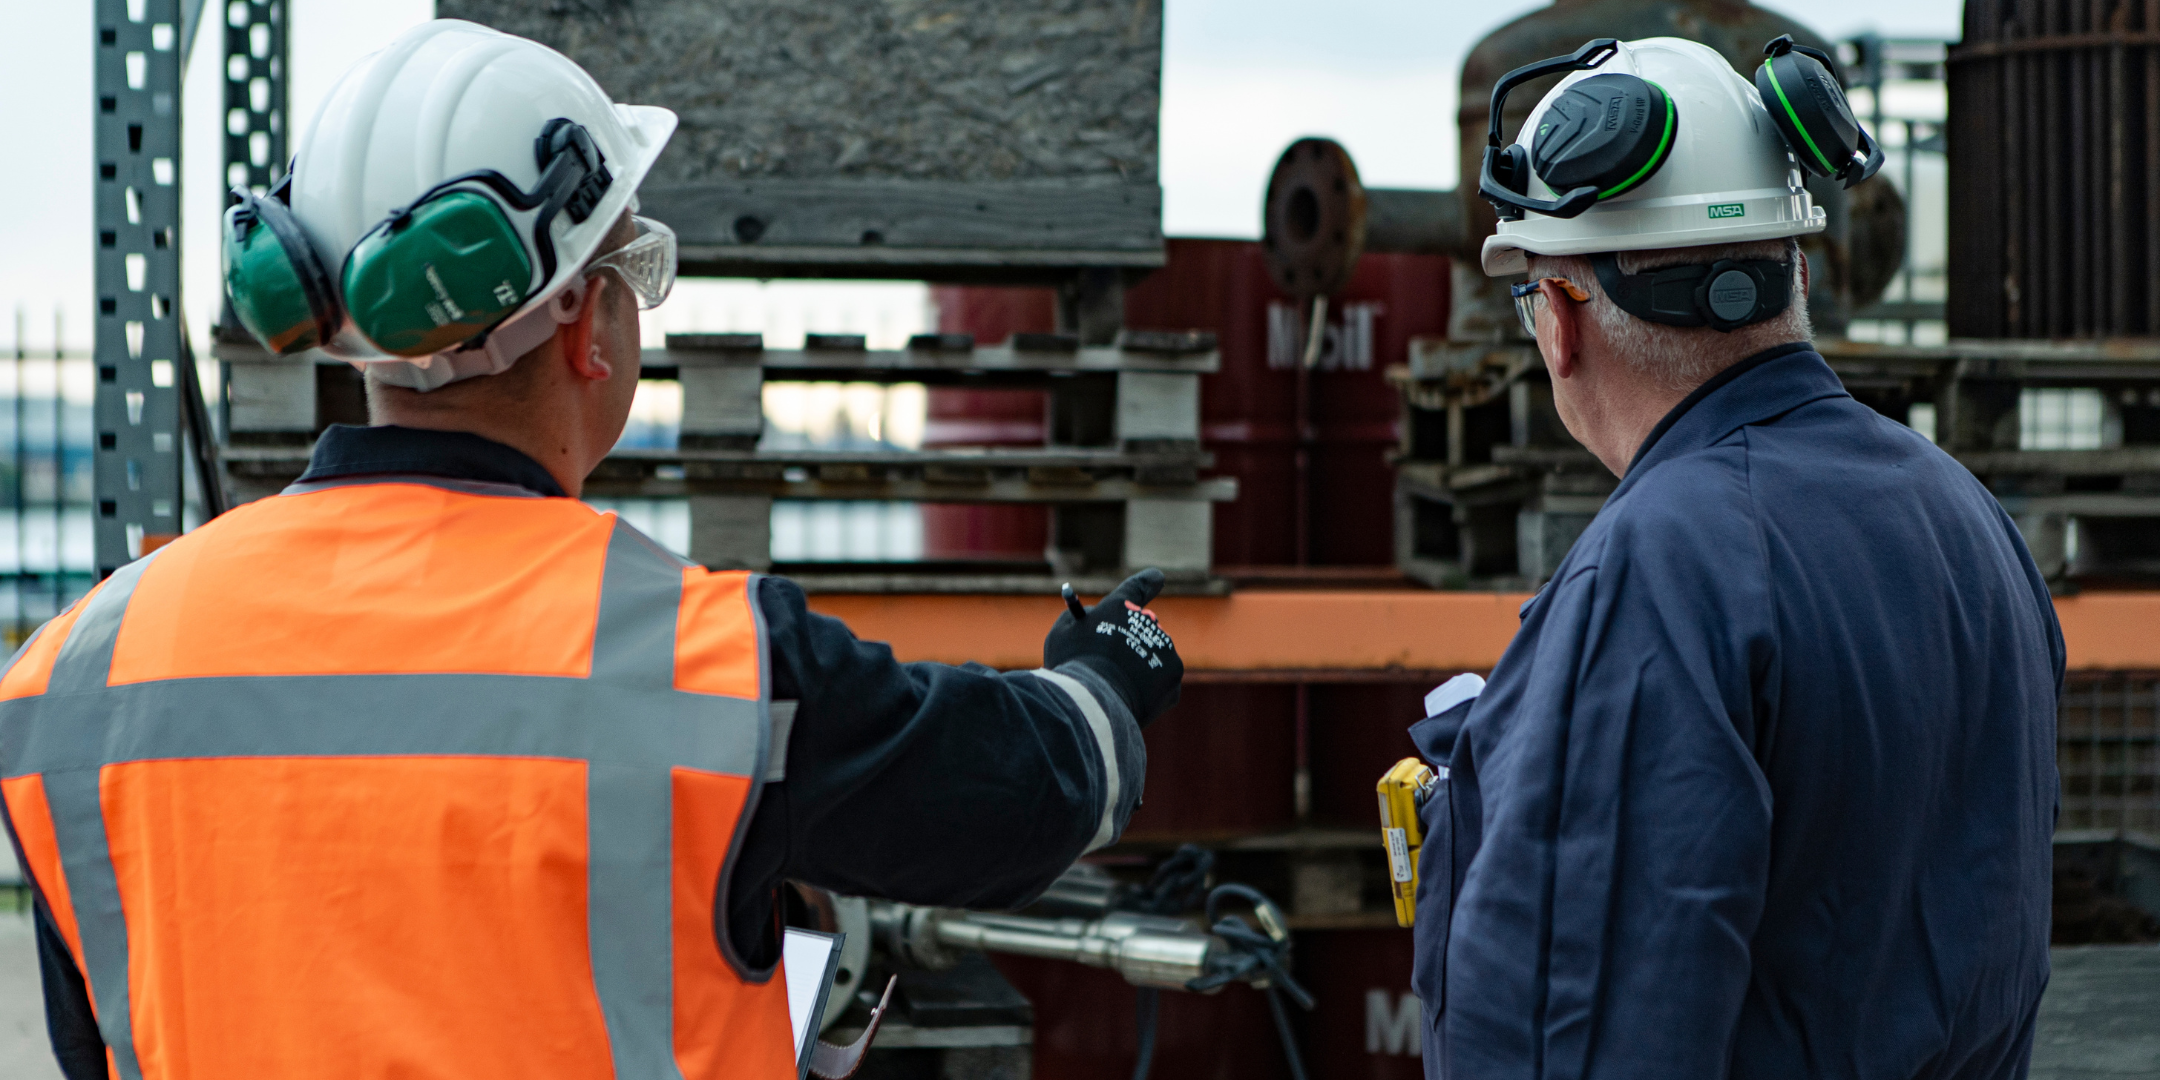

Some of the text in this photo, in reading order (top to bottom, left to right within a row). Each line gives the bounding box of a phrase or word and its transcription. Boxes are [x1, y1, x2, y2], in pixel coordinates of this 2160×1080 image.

[1607, 99, 1621, 130] MSA
[1709, 205, 1743, 217] MSA
[1715, 290, 1751, 302] MSA
[1267, 300, 1374, 369] Mbil
